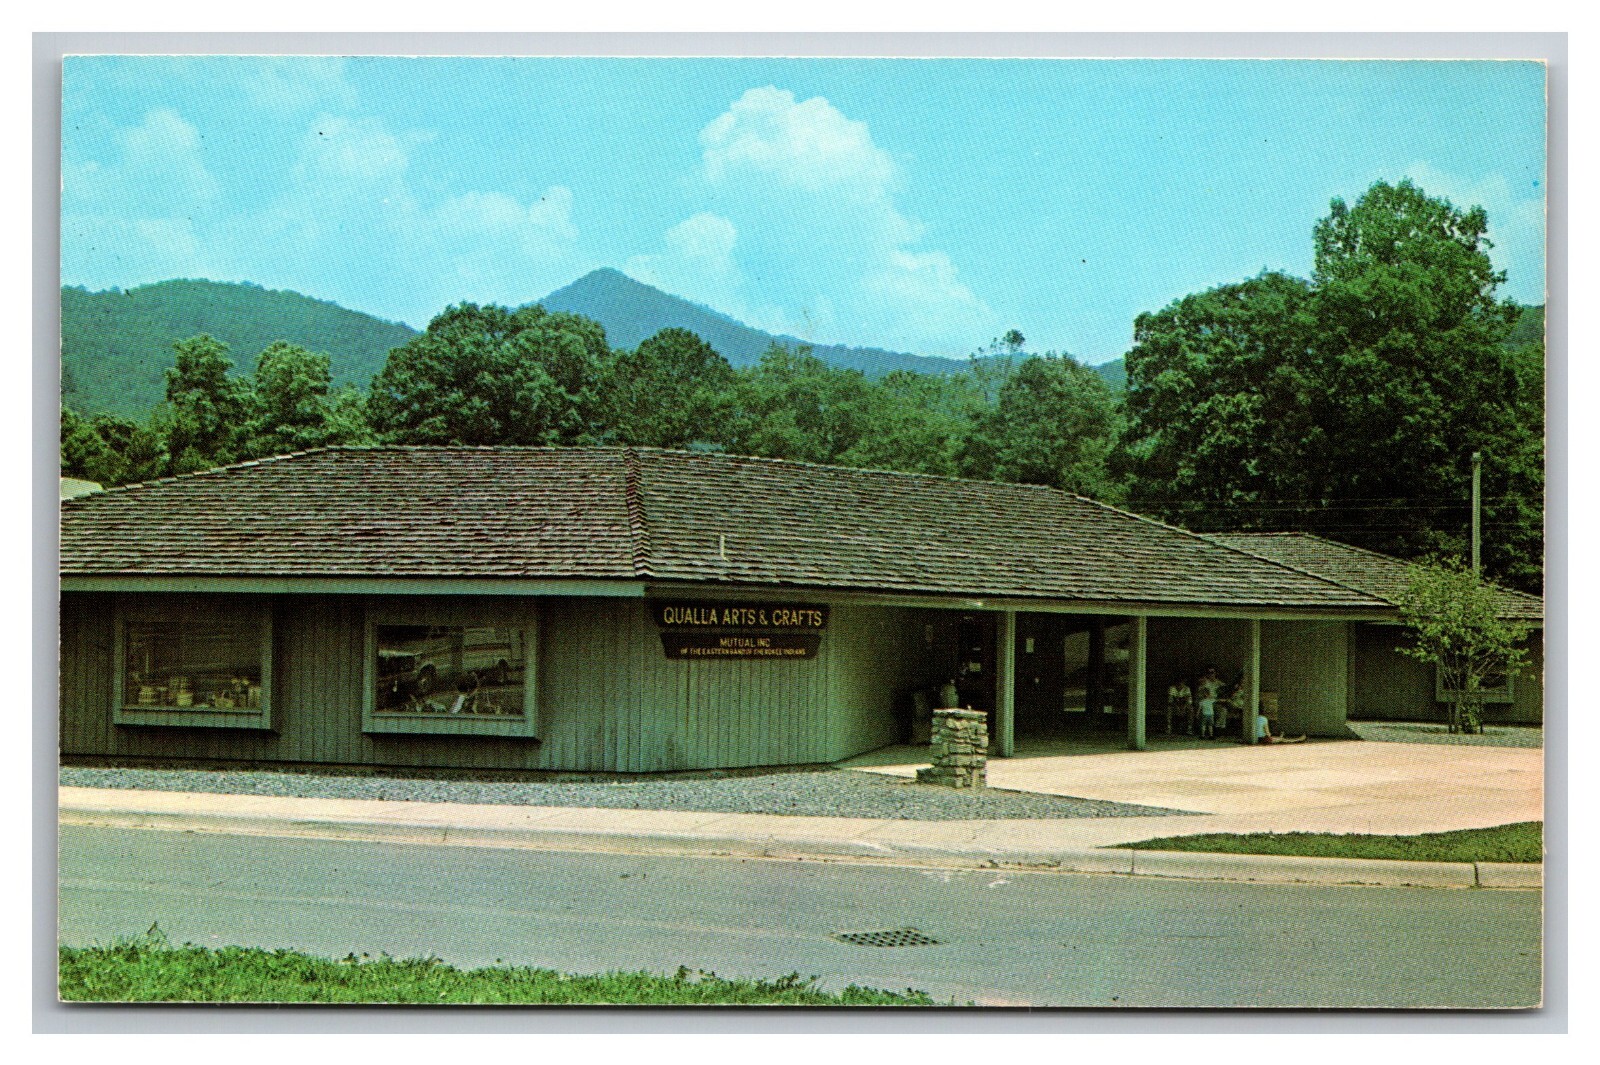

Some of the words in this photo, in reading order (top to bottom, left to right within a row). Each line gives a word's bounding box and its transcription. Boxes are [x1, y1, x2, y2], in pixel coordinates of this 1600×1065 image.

[663, 606, 718, 625] QUALLA
[721, 608, 757, 625] ARTS
[759, 608, 769, 625] &
[771, 609, 823, 627] CRAFTS
[719, 636, 755, 648] MUTUAL
